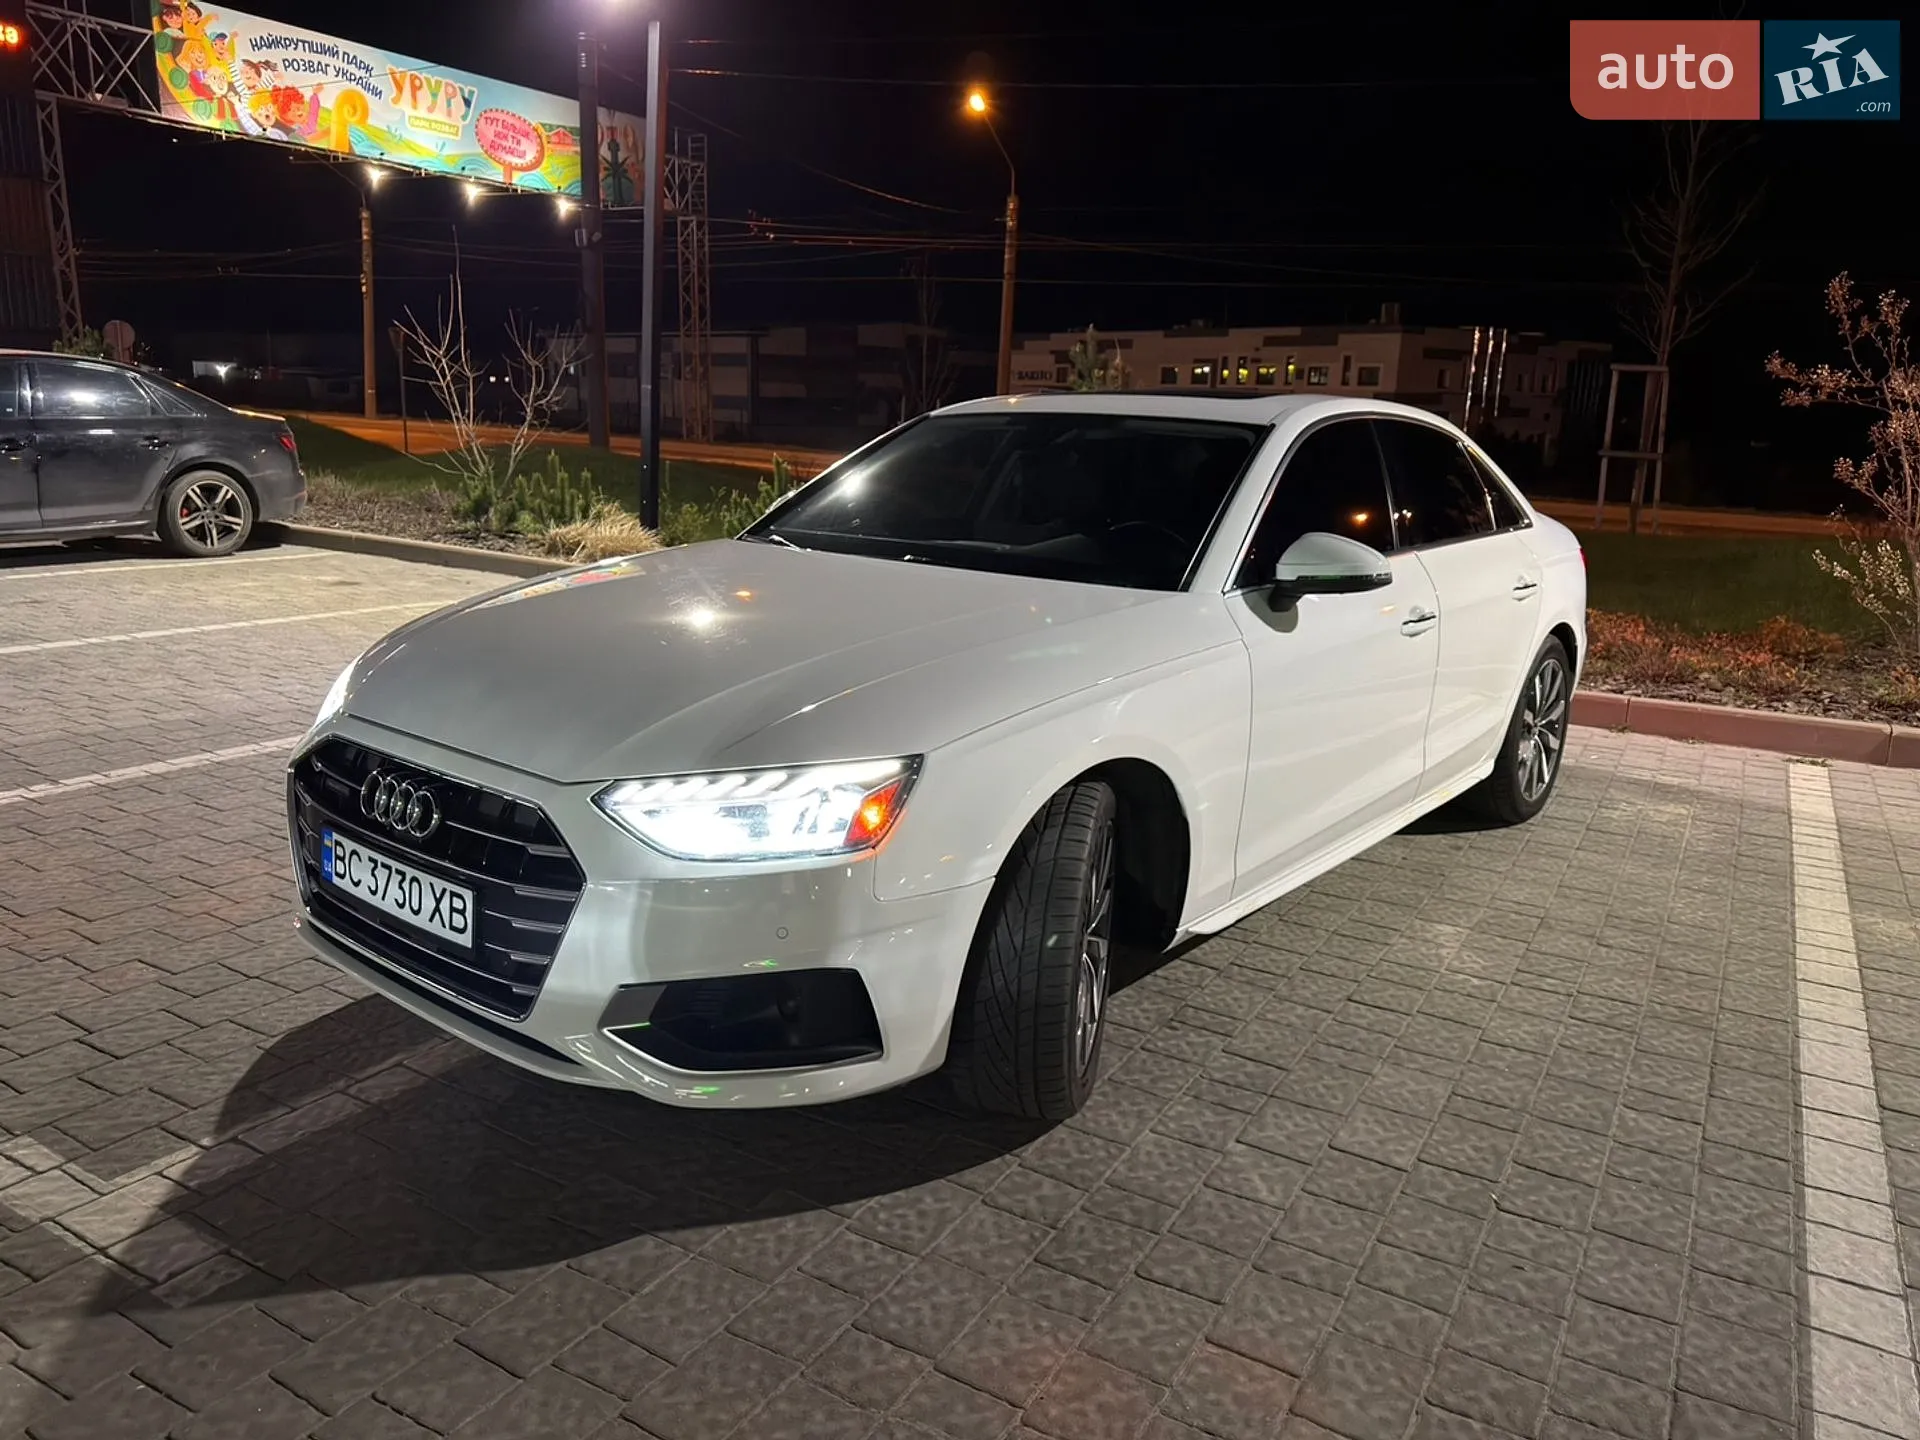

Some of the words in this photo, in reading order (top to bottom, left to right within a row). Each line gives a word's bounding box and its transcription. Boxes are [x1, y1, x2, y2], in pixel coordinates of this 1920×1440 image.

[249, 33, 340, 60] НАЙКРУТІШИЙ
[342, 51, 374, 77] ПАРК
[282, 58, 330, 75] РОЗВАГ
[333, 66, 383, 100] УКРАЇНИ
[387, 67, 476, 122] УРУРУ
[484, 117, 500, 128] ТУТ
[334, 839, 362, 887] BC
[367, 856, 423, 917] 3730
[429, 882, 468, 935] XB
